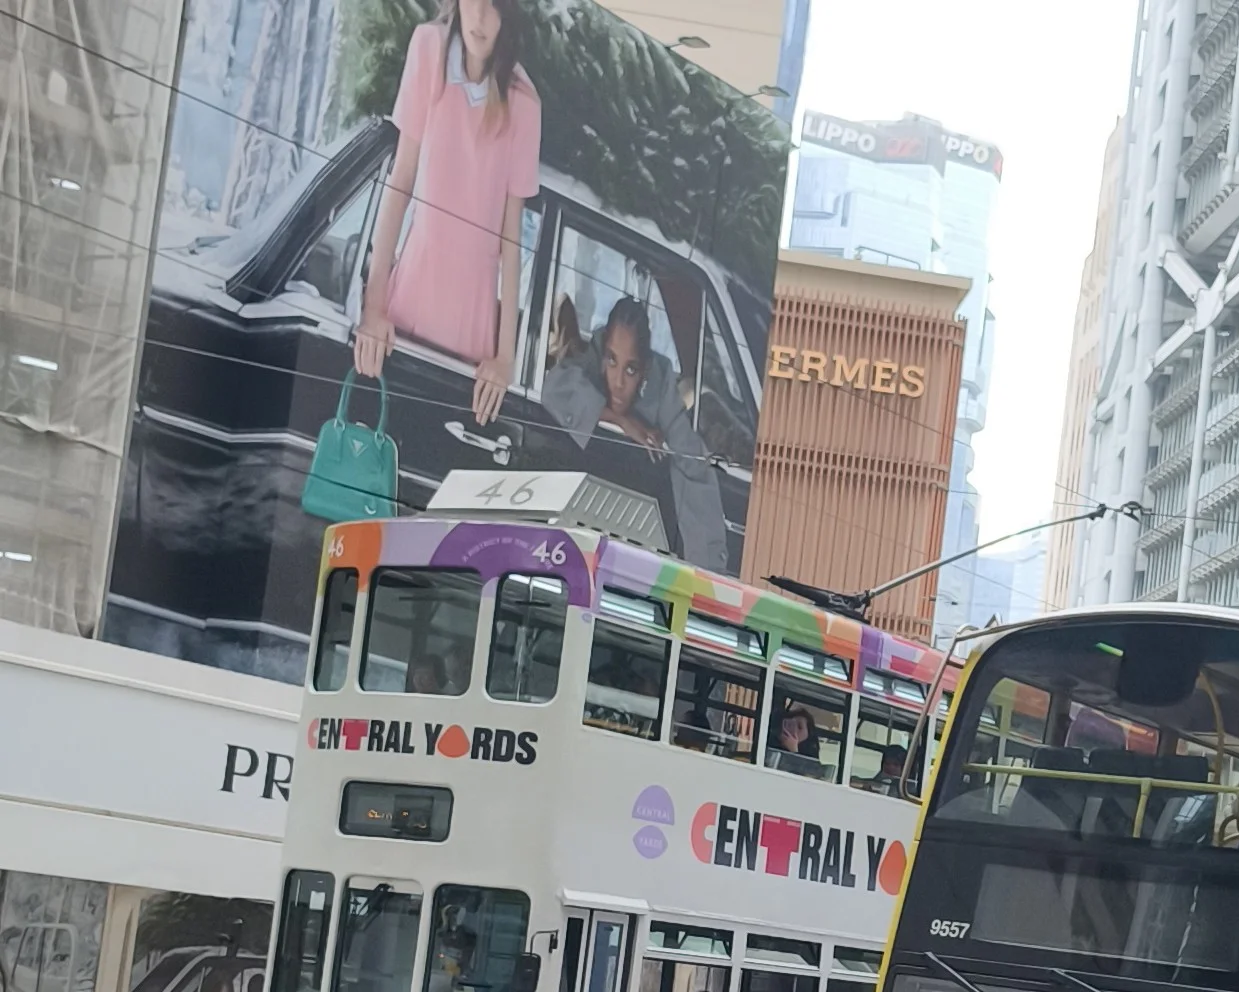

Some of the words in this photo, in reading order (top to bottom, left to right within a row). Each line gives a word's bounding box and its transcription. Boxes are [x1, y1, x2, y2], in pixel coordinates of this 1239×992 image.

[802, 115, 877, 153] LIPPO
[474, 475, 543, 506] 46
[328, 535, 345, 558] 46
[531, 540, 567, 565] 46
[307, 718, 416, 754] CENTRAL
[218, 742, 294, 802] PR
[690, 801, 856, 888] CENTRAL
[929, 919, 970, 939] 9557
